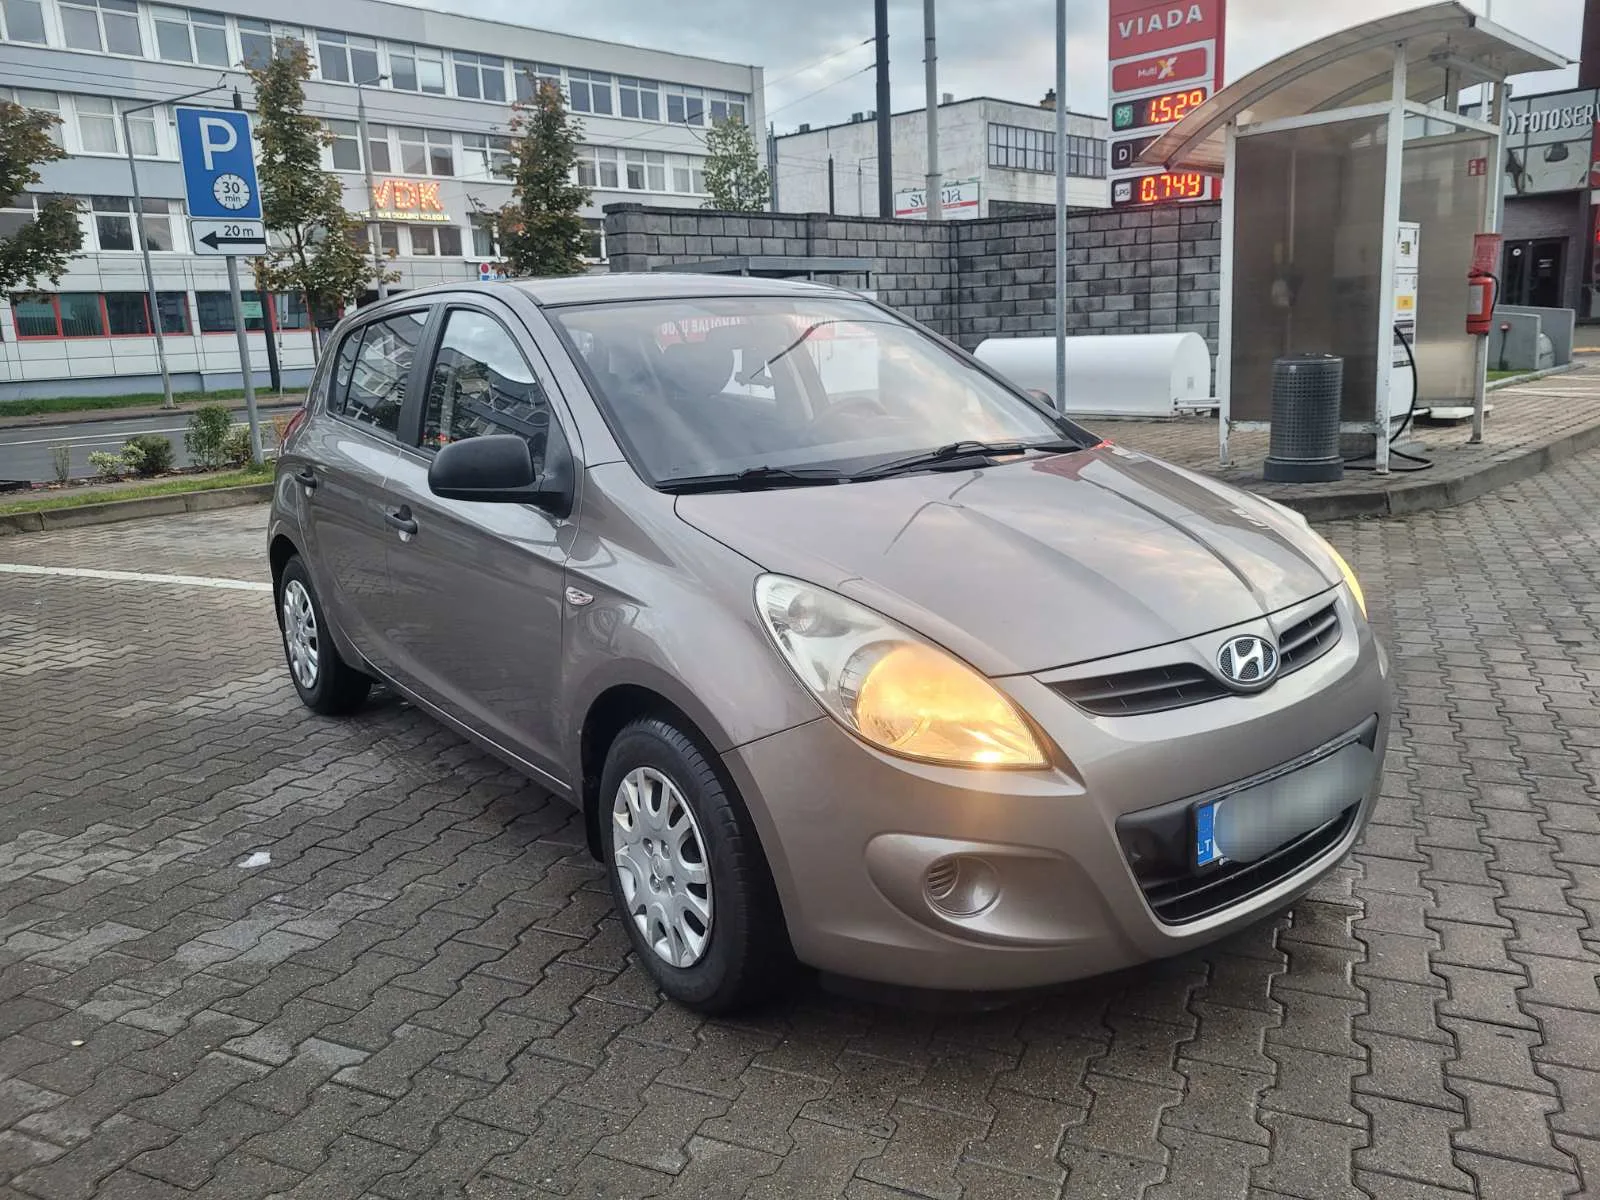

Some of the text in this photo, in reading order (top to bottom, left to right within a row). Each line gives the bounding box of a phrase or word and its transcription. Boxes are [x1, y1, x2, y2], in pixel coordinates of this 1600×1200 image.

[1118, 4, 1203, 38] VIADA
[199, 116, 237, 171] P
[1118, 148, 1128, 161] D
[222, 181, 240, 194] 30
[373, 180, 444, 211] VDK
[1115, 173, 1200, 202] LPG 0.749
[225, 195, 240, 203] min
[224, 225, 254, 237] 20 m
[1197, 838, 1212, 855] LT
